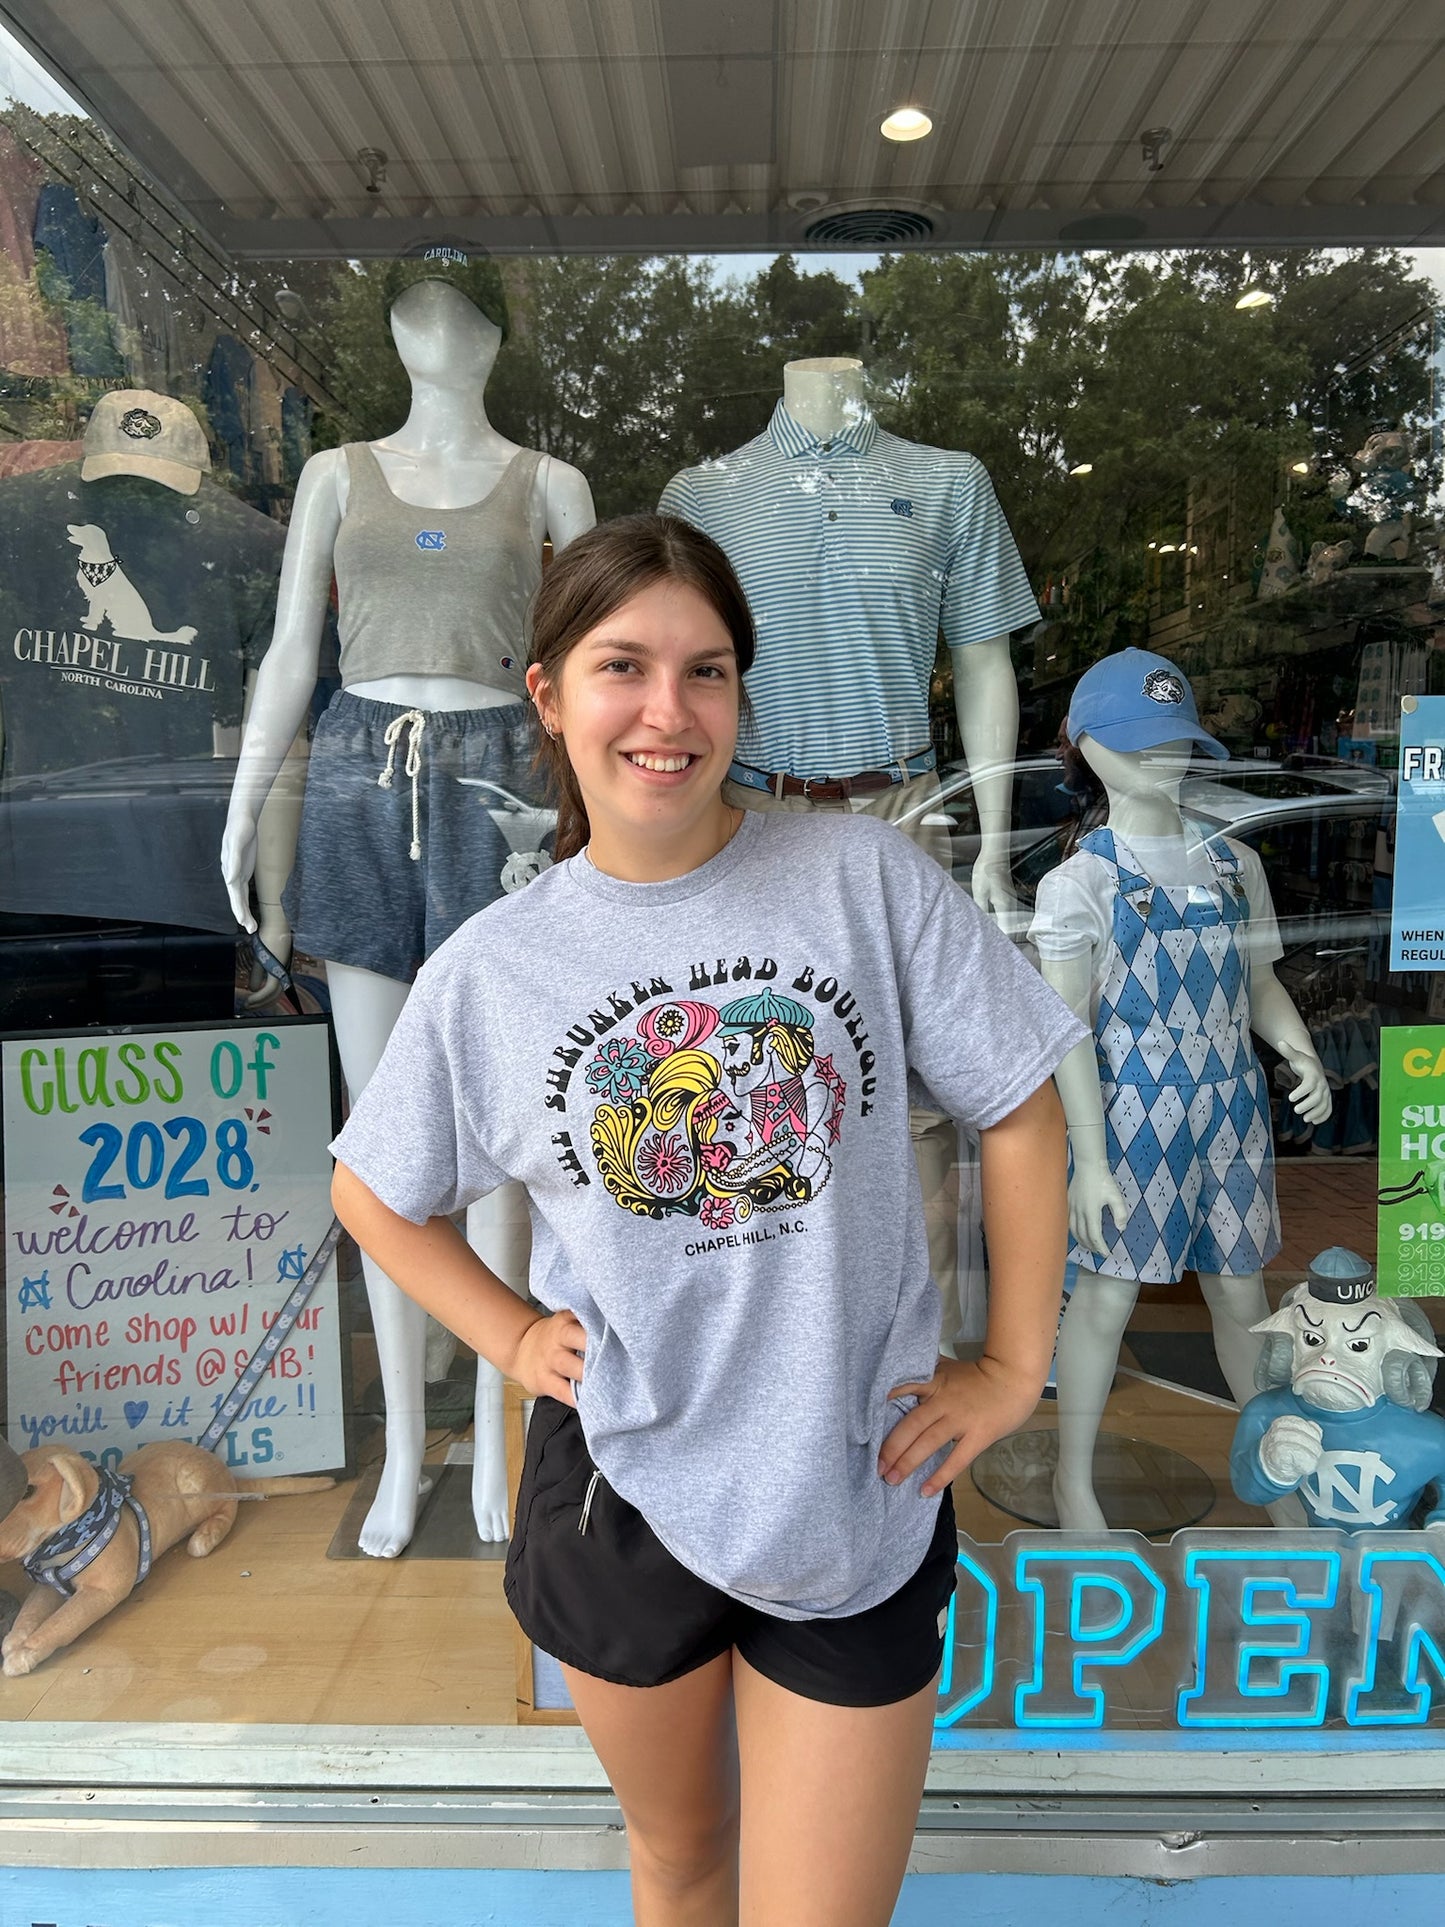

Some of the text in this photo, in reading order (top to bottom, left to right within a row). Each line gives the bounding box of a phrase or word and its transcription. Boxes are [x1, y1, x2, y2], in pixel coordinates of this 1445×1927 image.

[424, 247, 468, 267] CAROLINA
[13, 628, 216, 692] CHAPEL HILL
[61, 672, 163, 700] NORTH CAROLINA
[1403, 746, 1445, 781] FR
[1401, 930, 1444, 942] WHEN
[544, 975, 674, 1113] SHRUNKEN
[688, 955, 778, 991] HEAD
[791, 965, 877, 1118] BOUTIQUE
[13, 1204, 290, 1256] welcome to
[778, 1220, 808, 1236] N.C.
[66, 1248, 255, 1310] Carolina!
[1337, 1280, 1373, 1299] UNC
[25, 1321, 110, 1355] come
[125, 1312, 197, 1353] shop
[53, 1354, 182, 1396] friends
[160, 1396, 194, 1427] it
